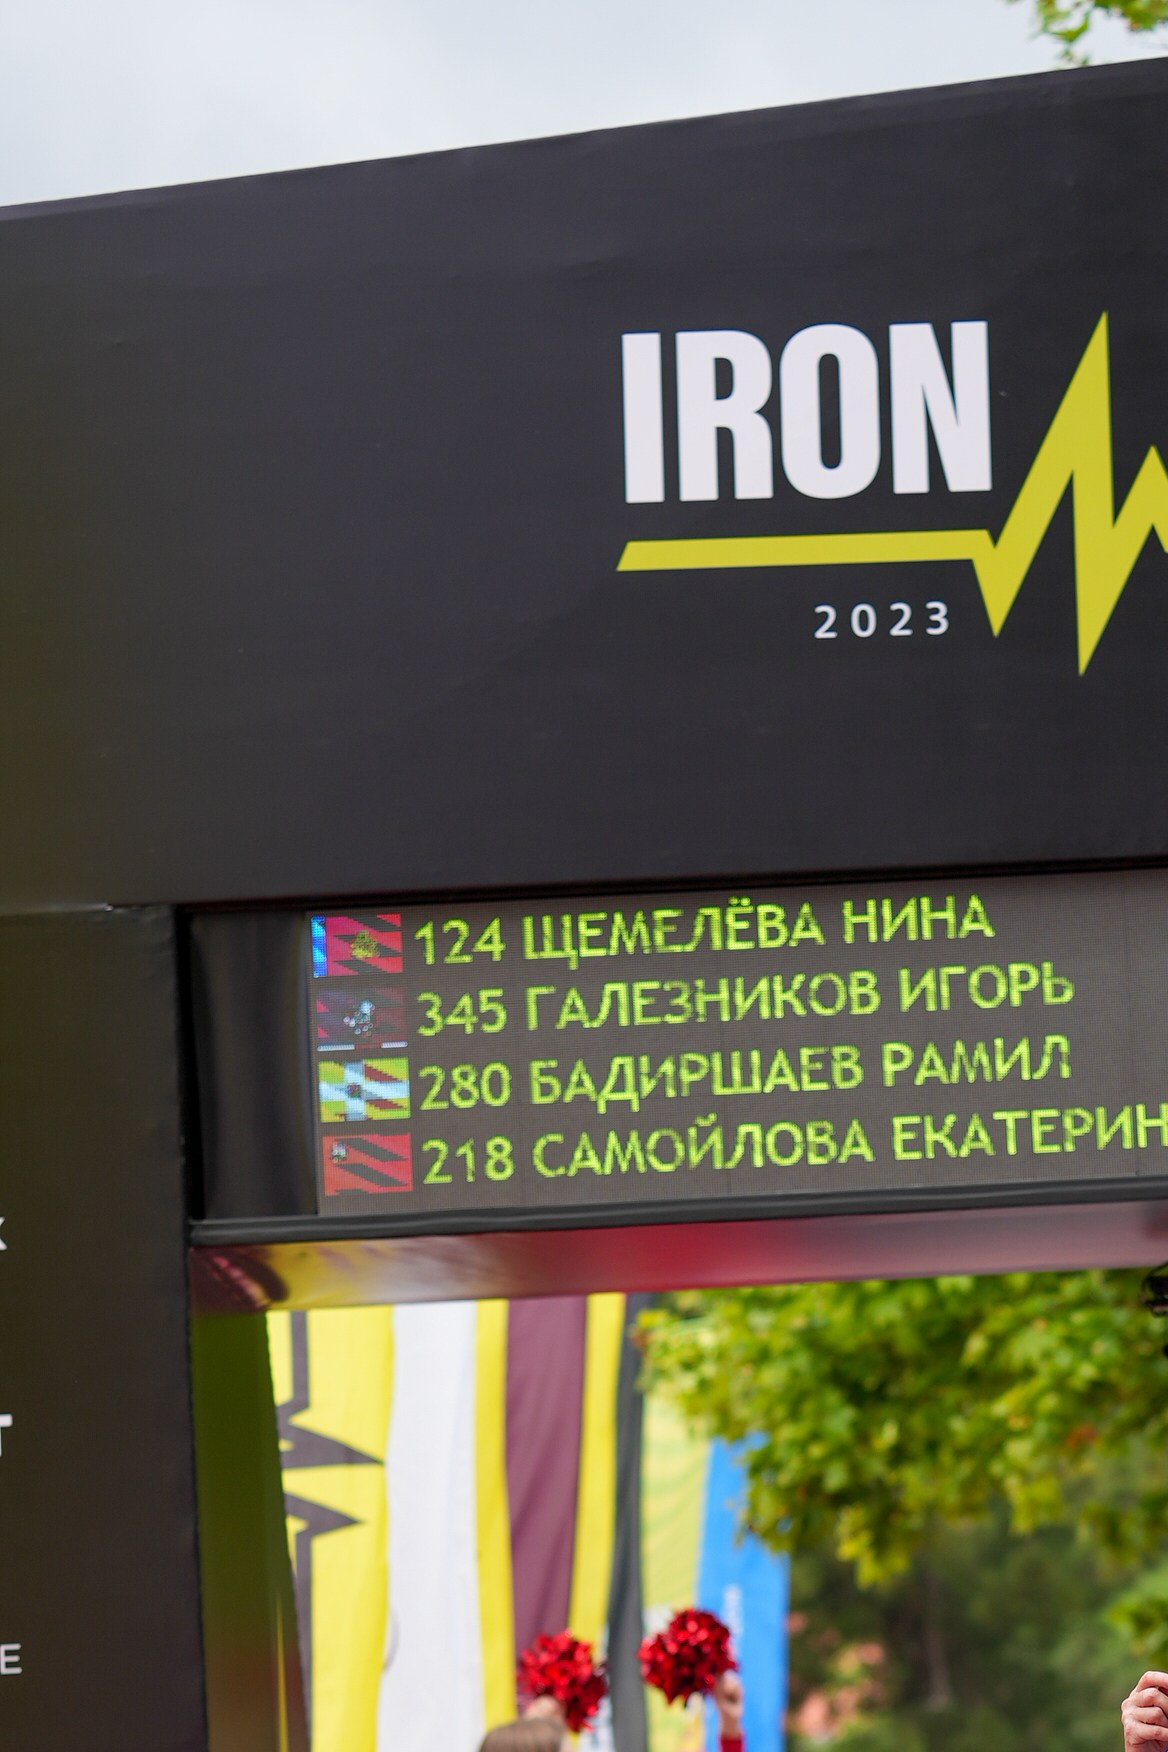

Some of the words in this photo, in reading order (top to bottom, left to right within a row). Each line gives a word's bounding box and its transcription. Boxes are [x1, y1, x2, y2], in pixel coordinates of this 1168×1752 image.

[621, 319, 993, 504] IRON
[813, 599, 951, 640] 2023
[414, 917, 507, 965] 124
[521, 896, 828, 971] ЩЕМЕЛЁВА
[841, 893, 996, 945] НИНА
[417, 986, 508, 1037] 345
[525, 968, 883, 1032] ГАЛЕЗНИКОВ
[898, 960, 1076, 1013] ИГОРЬ
[418, 1061, 513, 1111] 280
[528, 1043, 866, 1115] БАДИРШАЕВ
[881, 1033, 1073, 1088] РАМИЛ
[421, 1135, 516, 1185] 218
[531, 1111, 876, 1180] САМОЙЛОВА
